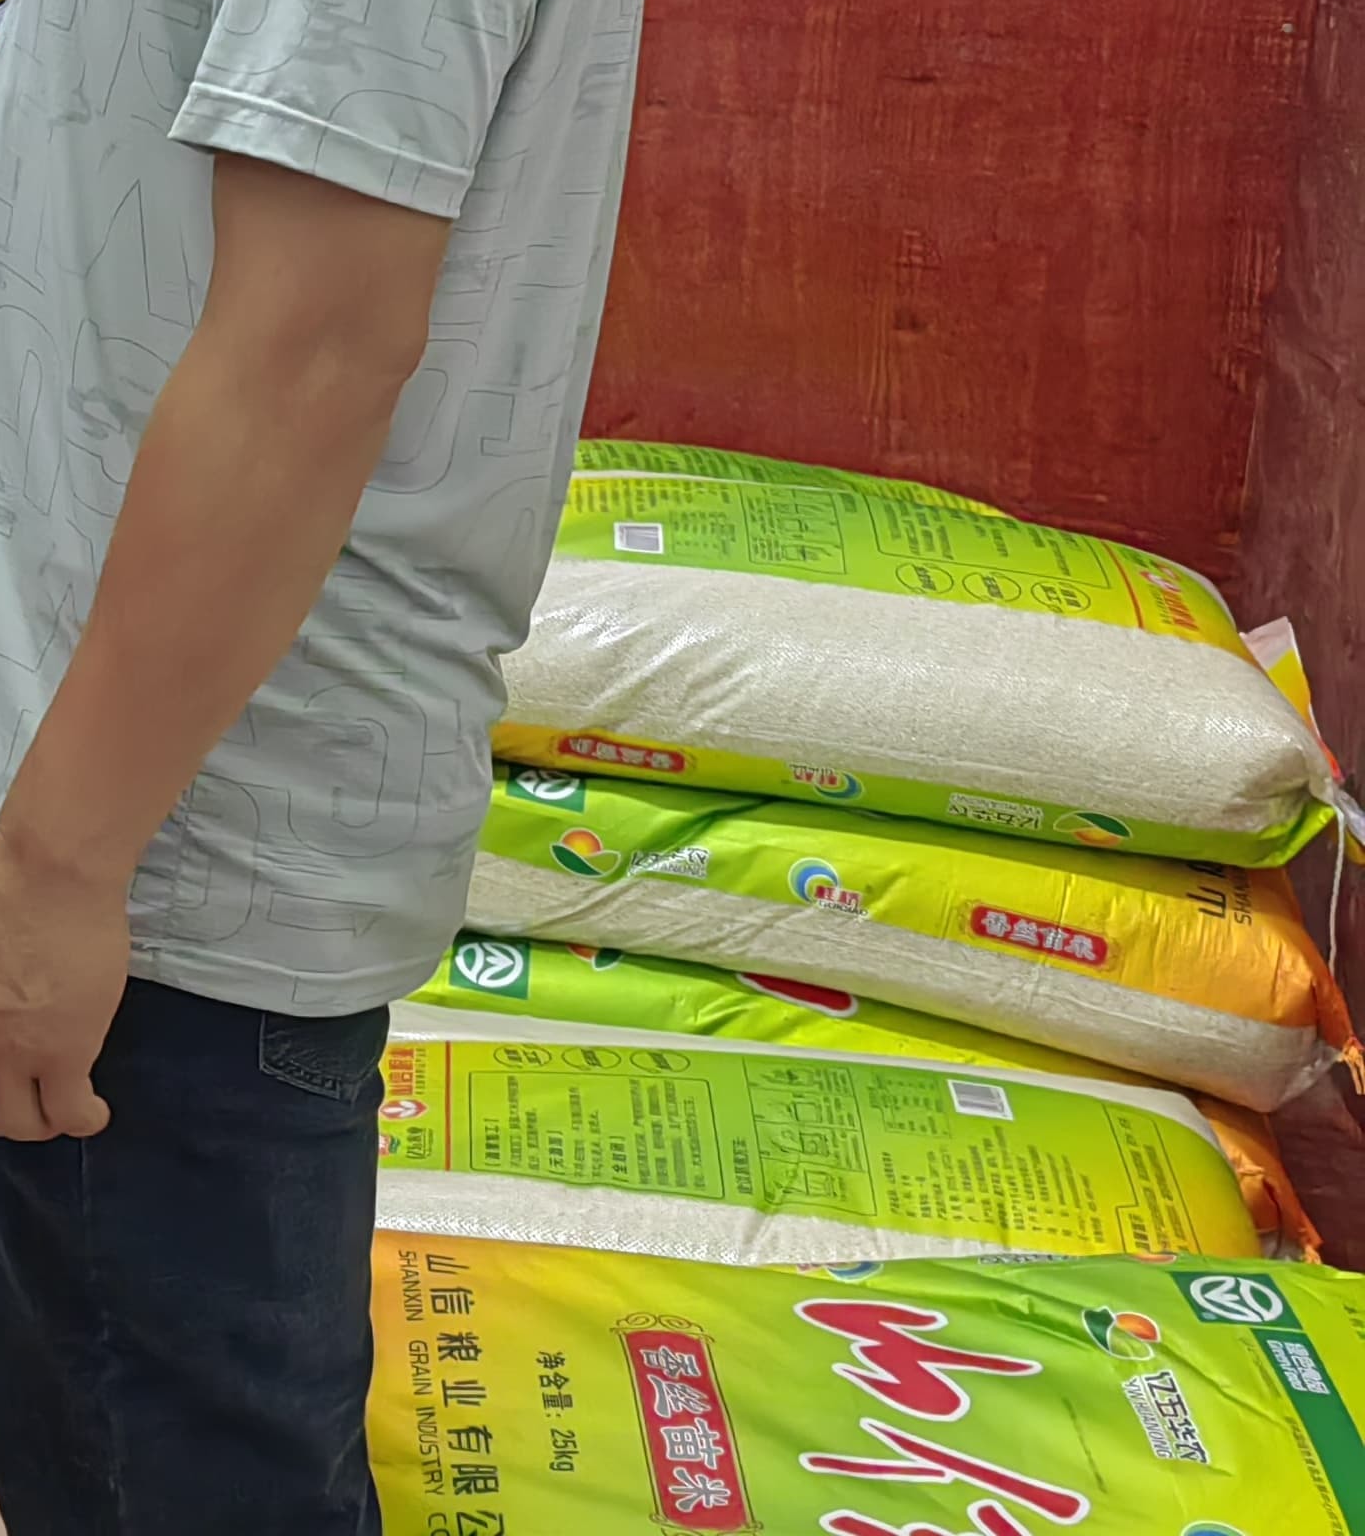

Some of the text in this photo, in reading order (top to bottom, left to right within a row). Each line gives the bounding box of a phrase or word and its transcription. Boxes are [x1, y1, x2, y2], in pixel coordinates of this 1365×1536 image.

[398, 1249, 424, 1322] SHANXIN
[408, 1340, 433, 1396] GRAIN
[416, 1405, 446, 1496] INDUSTRY
[549, 1427, 580, 1474] 25kg
[640, 1345, 732, 1513] 香丝苗米
[1144, 1370, 1209, 1465] 亿五华农
